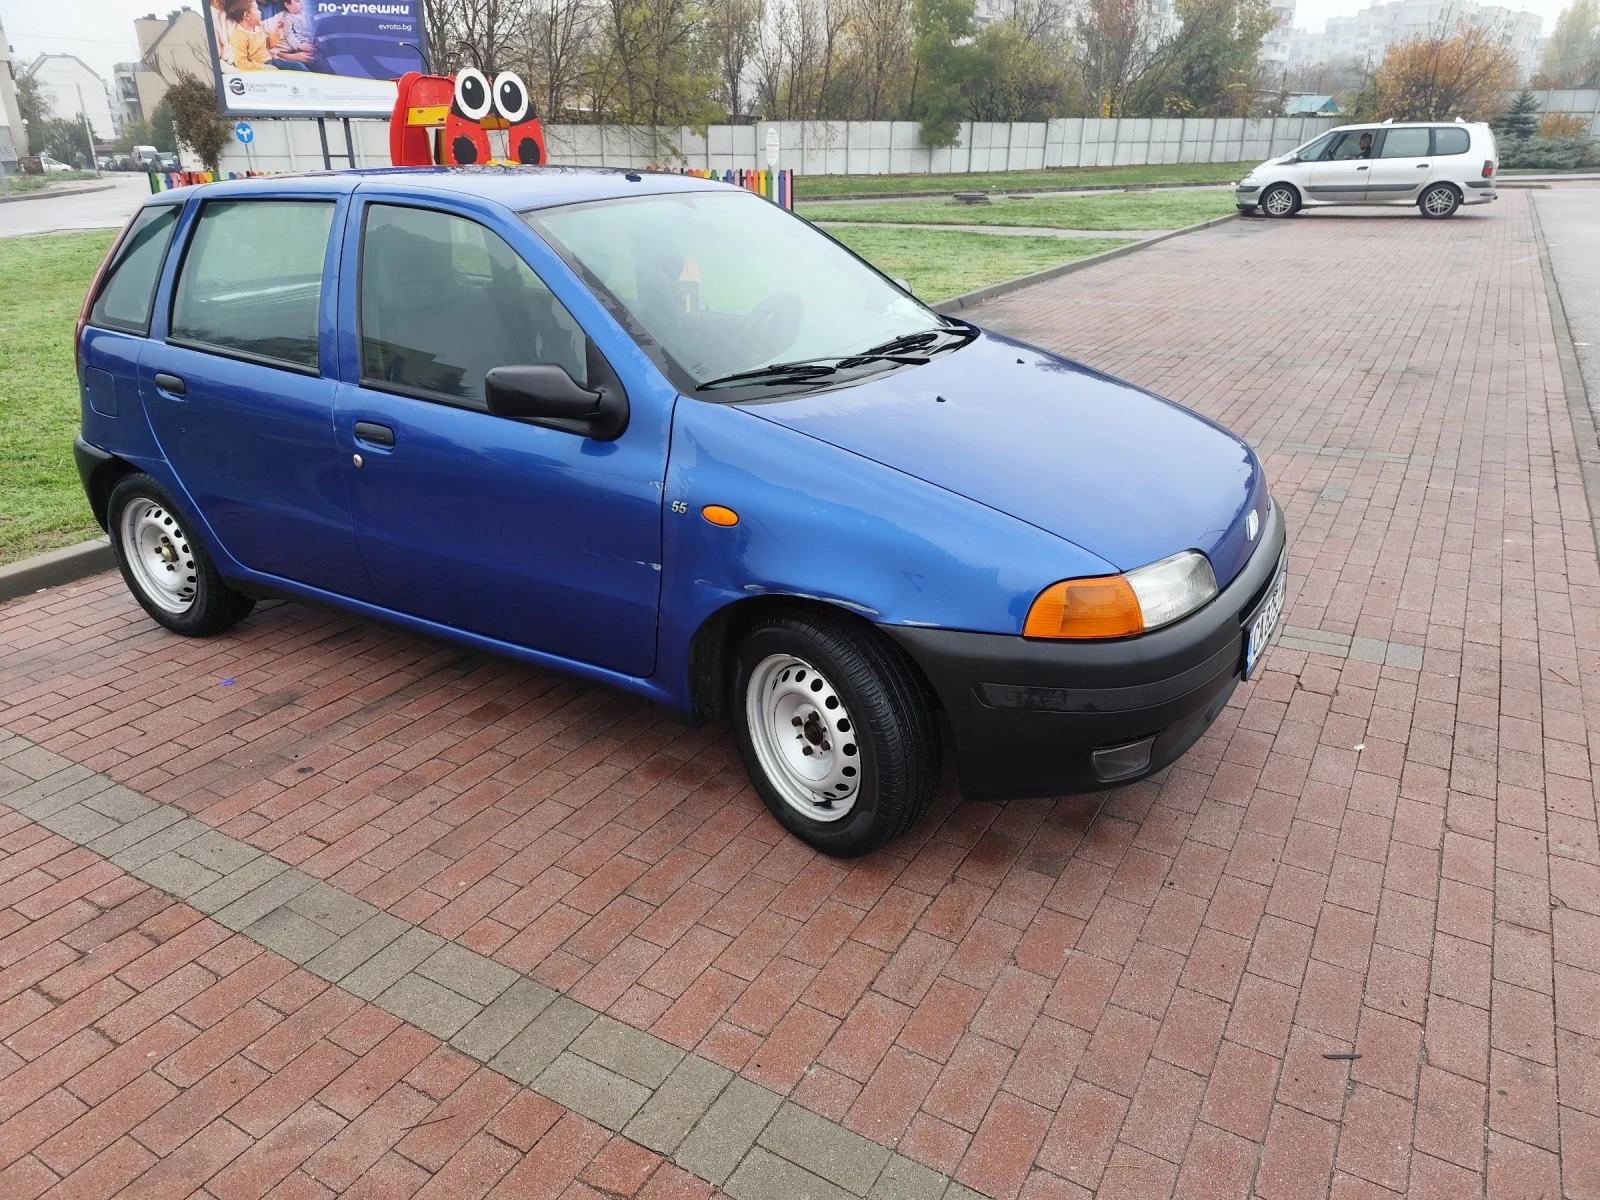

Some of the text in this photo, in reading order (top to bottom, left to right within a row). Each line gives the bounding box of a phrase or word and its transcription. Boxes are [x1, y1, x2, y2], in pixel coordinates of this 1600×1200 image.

[318, 3, 409, 15] по-успешни
[378, 23, 412, 31] evroto.bg
[671, 500, 688, 514] 55
